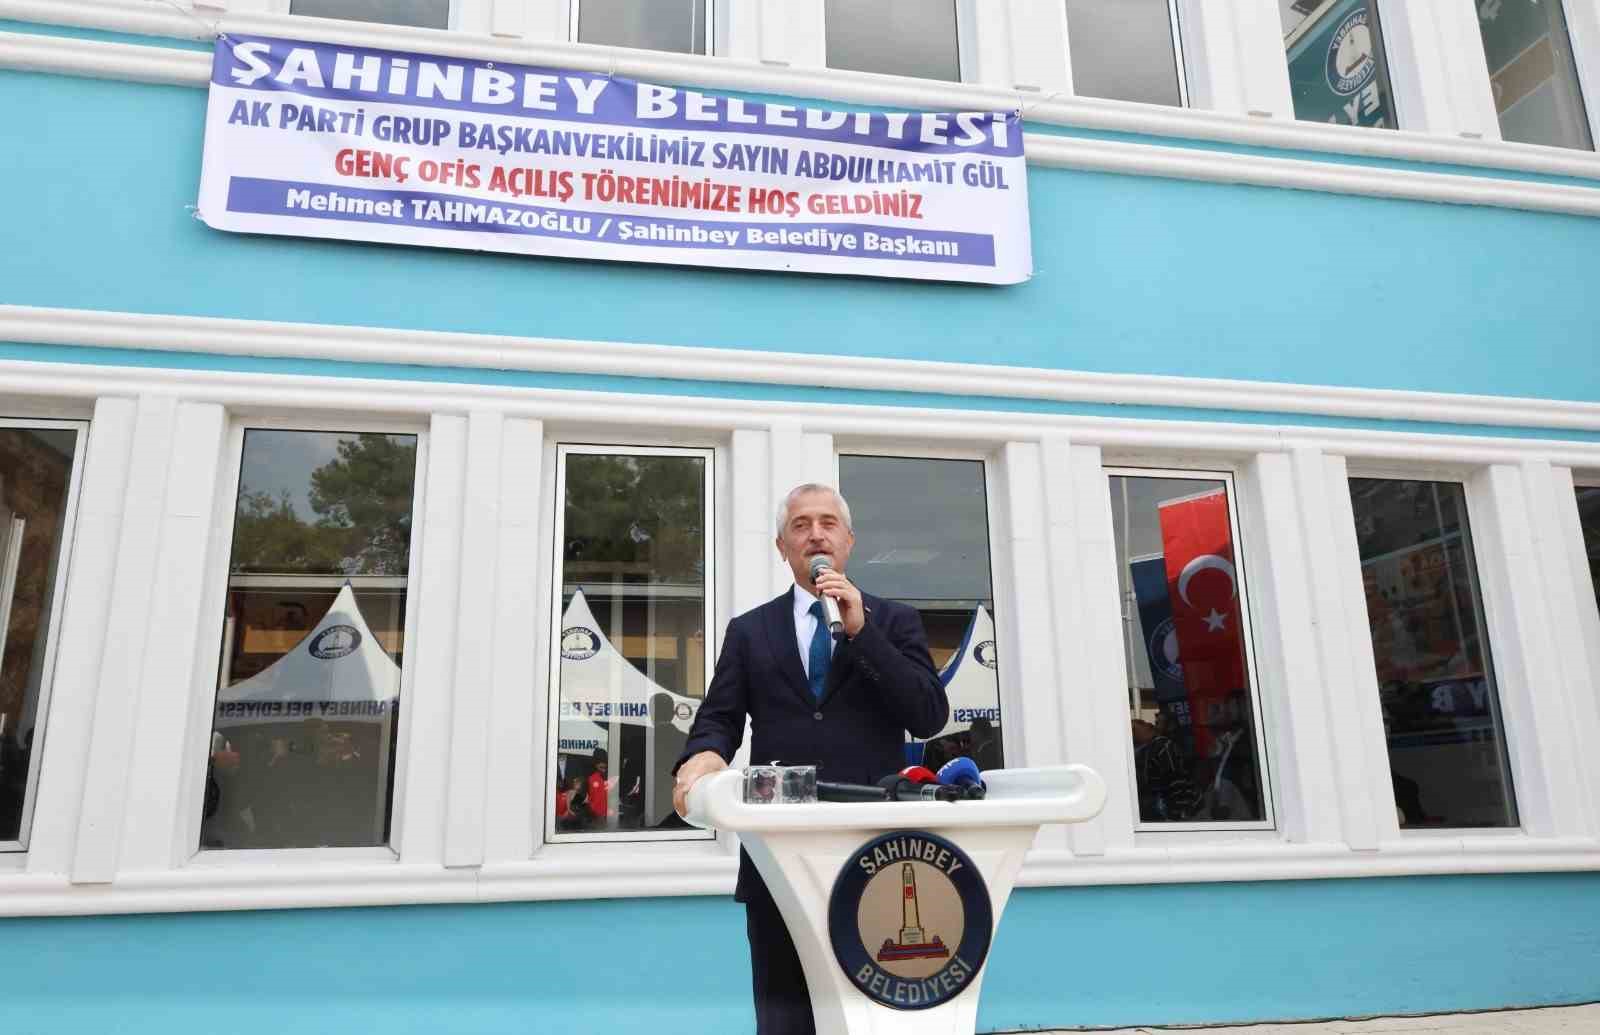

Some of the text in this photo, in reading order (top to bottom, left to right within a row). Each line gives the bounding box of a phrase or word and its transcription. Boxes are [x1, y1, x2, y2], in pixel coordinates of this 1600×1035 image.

[230, 42, 609, 115] ŞAHİNBEY
[228, 99, 1009, 190] AK PARTİ GRUP BAŞKANVEKİLİMİZ SAYIN ABDULHAMİT GÜL
[334, 148, 923, 219] GENÇ OFİS AÇILIŞ TÖRENİMİZE HOŞ GELDİNİZ
[286, 188, 959, 257] Mehmet TAHMAZOĞLU / Şahinbey Belediye Başkanı
[859, 836, 964, 875] ŞAHİNBEY
[855, 955, 972, 1004] BELEDİYESİ
